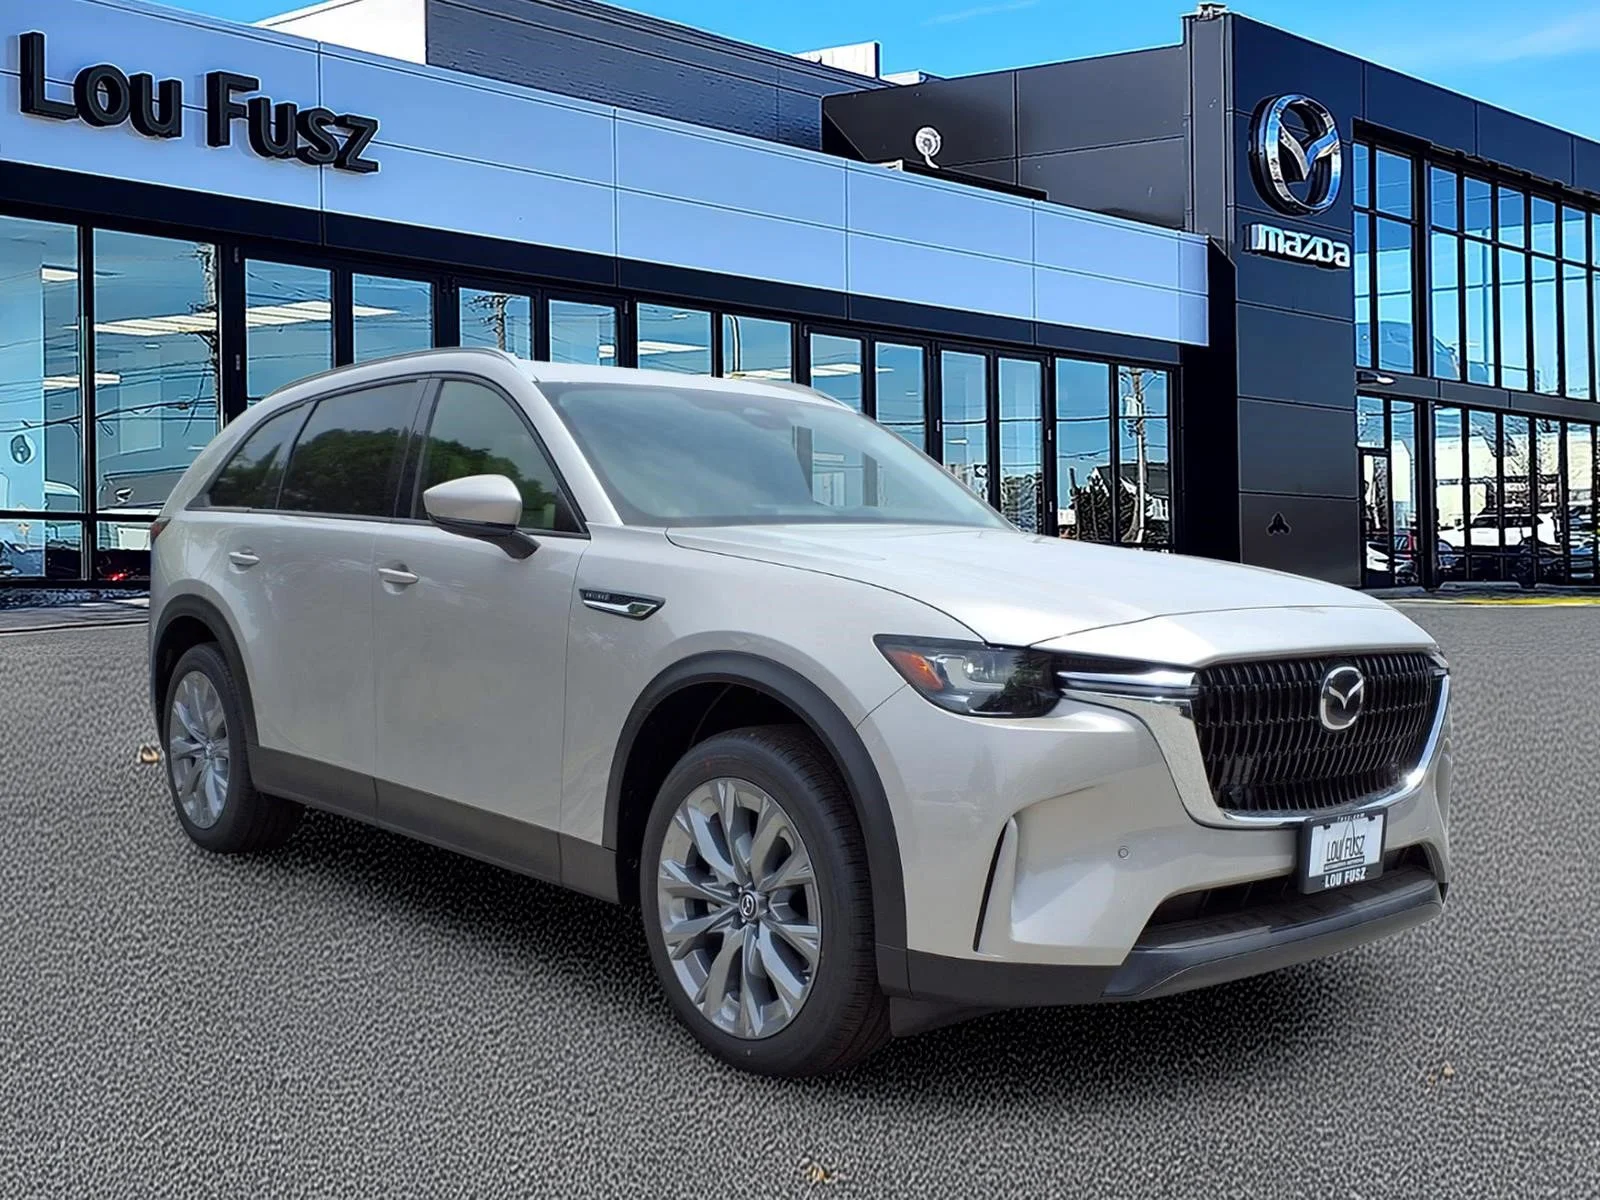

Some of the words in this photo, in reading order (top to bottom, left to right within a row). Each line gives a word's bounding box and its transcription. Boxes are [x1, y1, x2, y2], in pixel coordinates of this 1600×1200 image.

[18, 31, 183, 139] Lou
[206, 70, 381, 174] Fusz
[1327, 841, 1343, 861] LOU
[1344, 835, 1365, 857] FUSZ
[1325, 873, 1342, 888] LOU
[1344, 867, 1366, 883] FUSZ
